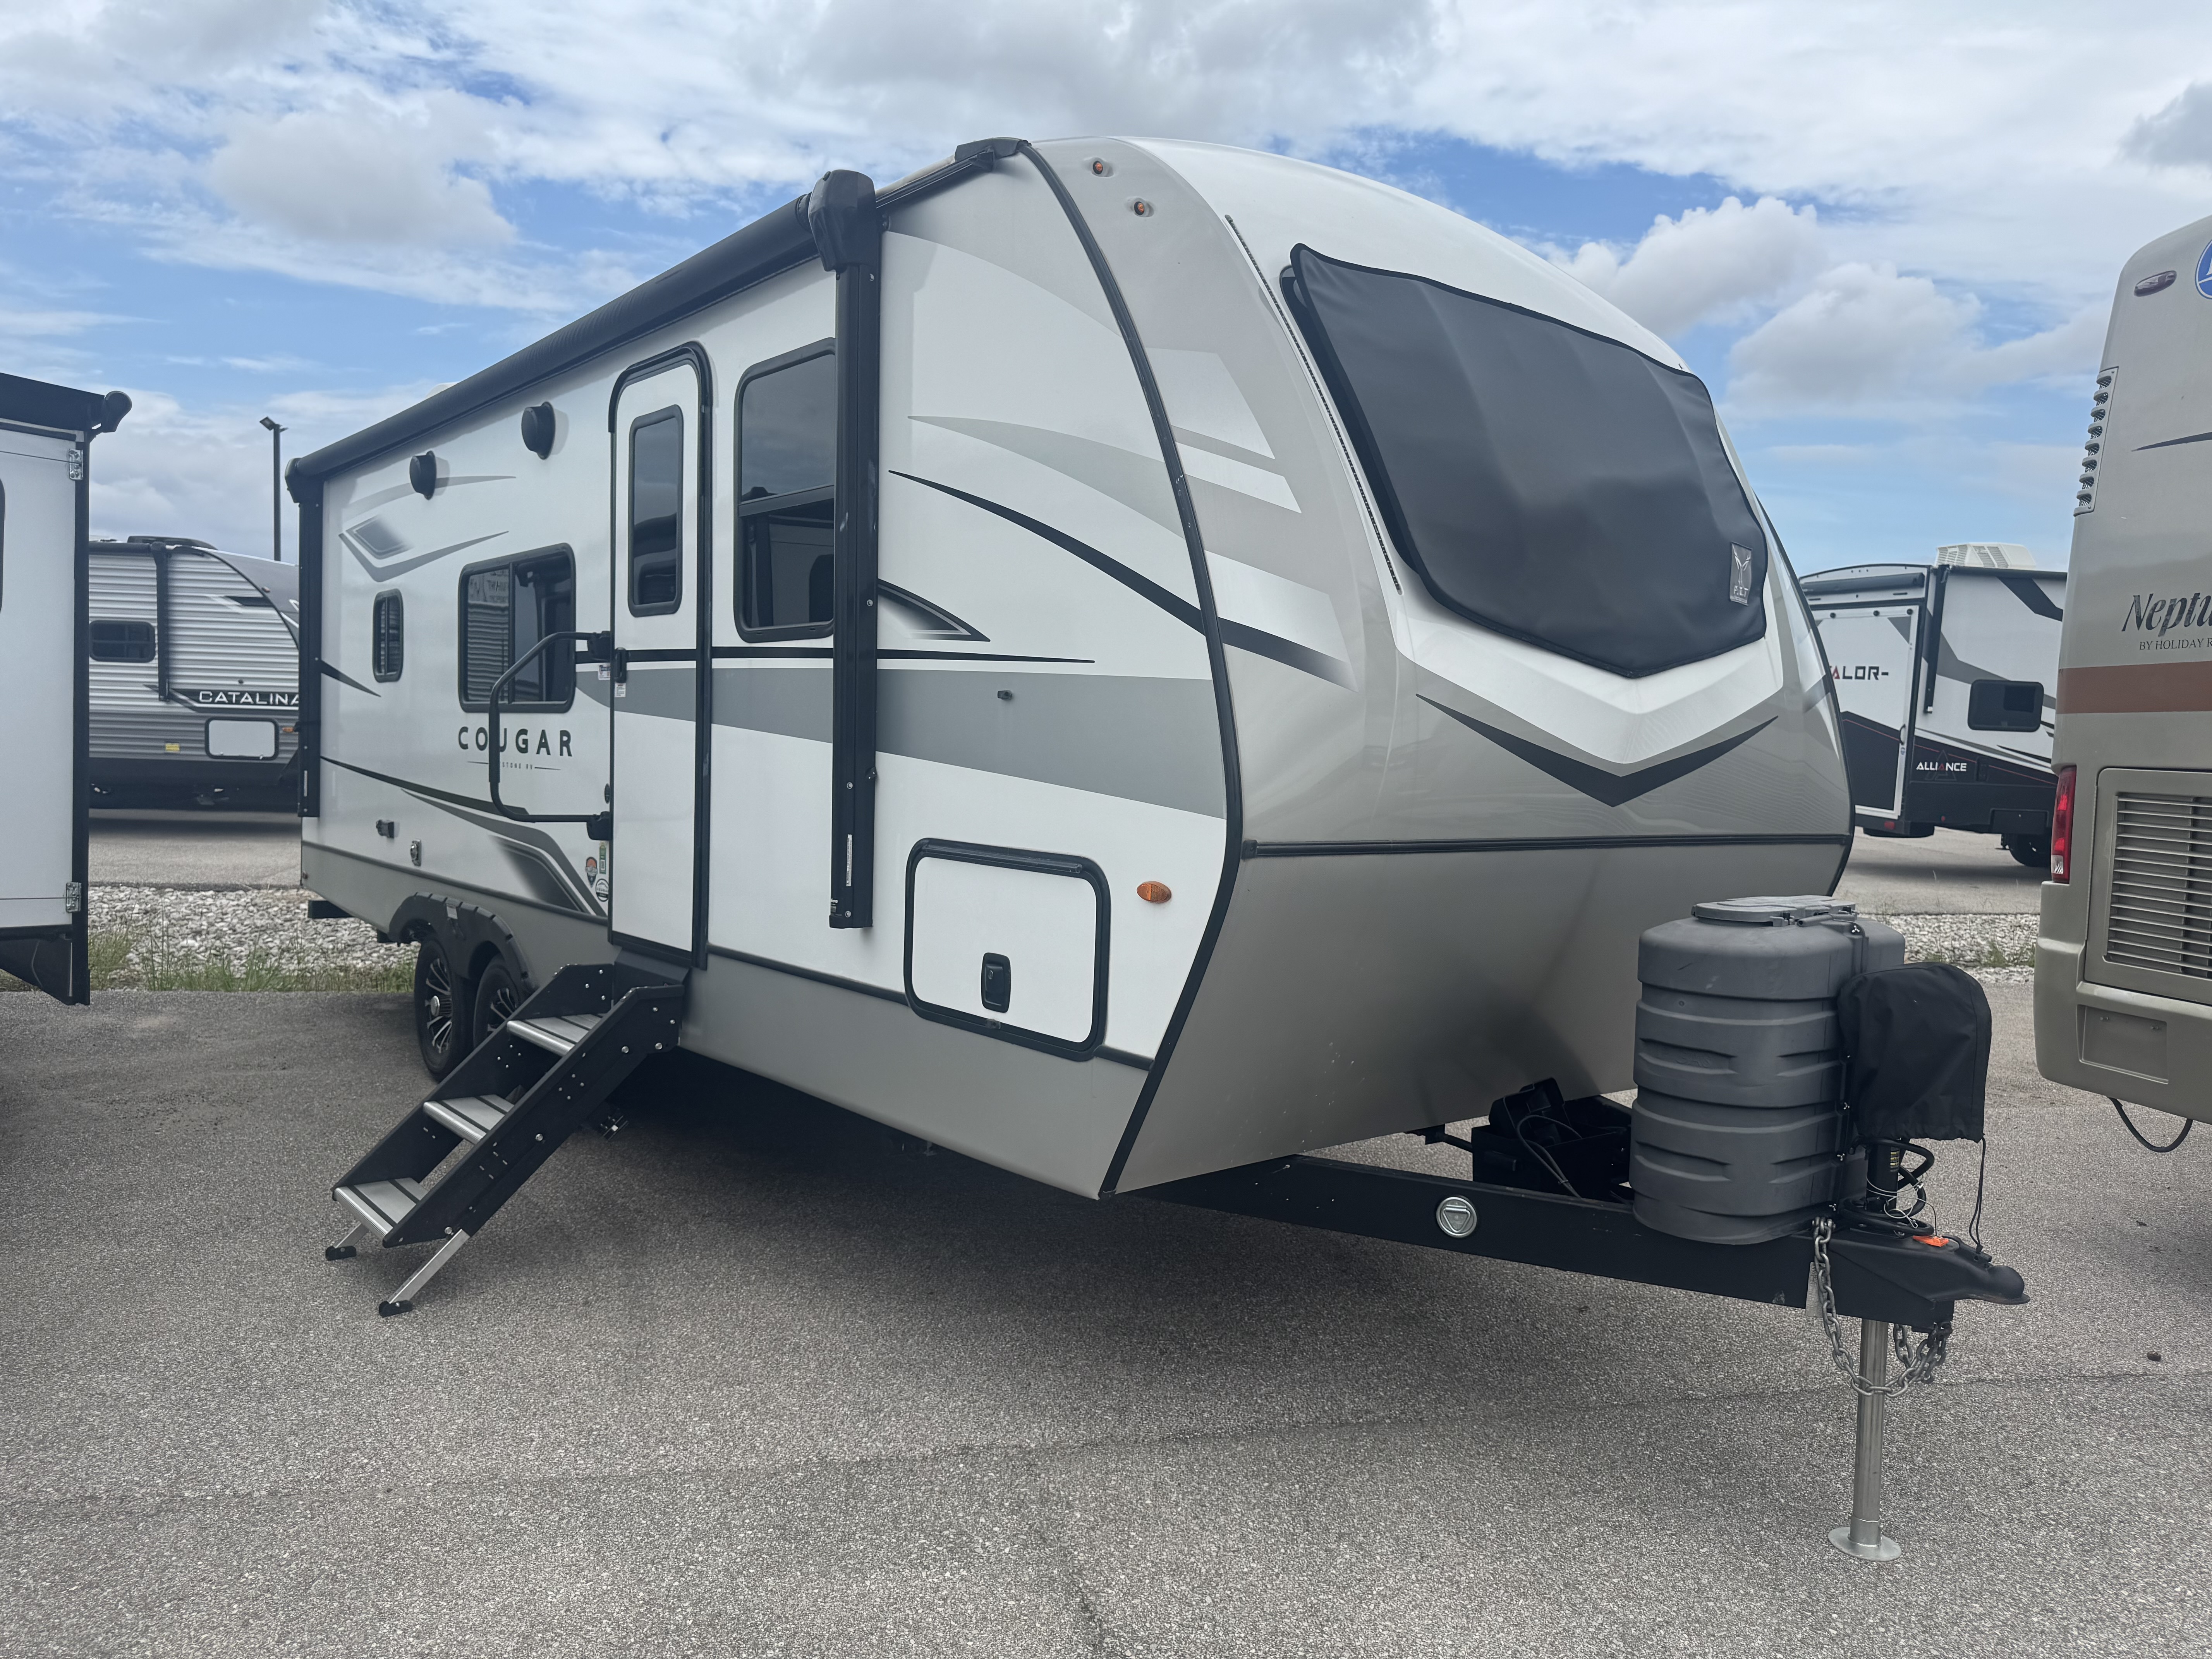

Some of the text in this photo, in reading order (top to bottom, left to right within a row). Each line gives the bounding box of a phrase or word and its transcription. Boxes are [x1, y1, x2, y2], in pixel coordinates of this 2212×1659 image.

[2140, 641, 2153, 650] BY
[2155, 638, 2204, 650] HOLIDAY
[1829, 665, 1889, 680] ALOR-
[458, 726, 572, 757] COUGAR
[1916, 762, 1967, 771] ALLIANCE
